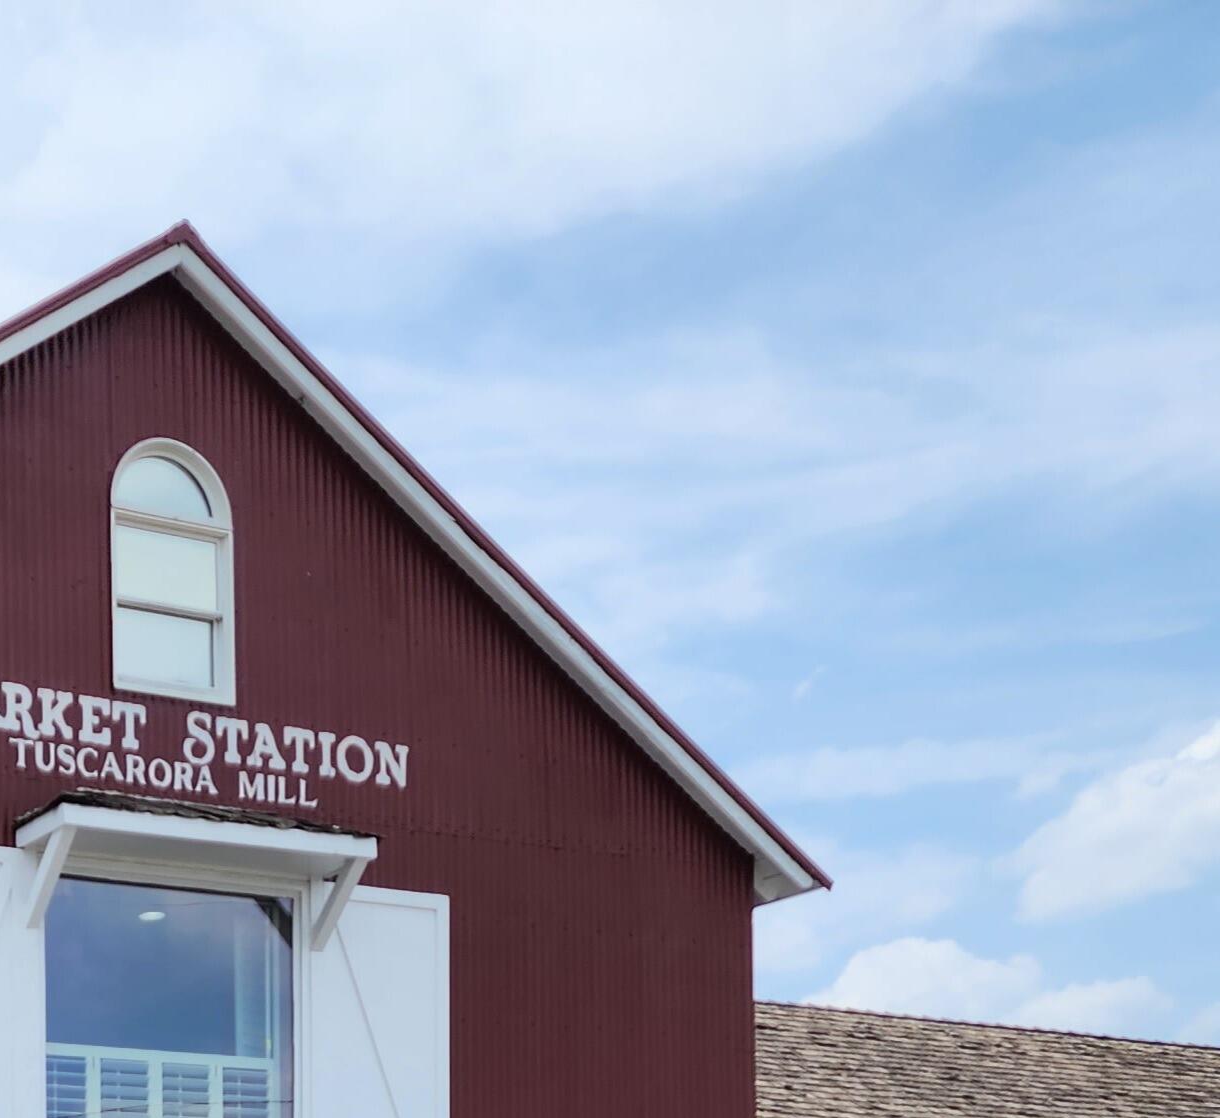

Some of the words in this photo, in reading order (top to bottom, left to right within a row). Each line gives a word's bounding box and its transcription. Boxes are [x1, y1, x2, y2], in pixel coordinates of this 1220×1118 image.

[9, 737, 218, 794] TUSCARORA
[238, 771, 318, 808] MILL
[183, 711, 409, 789] STATION
